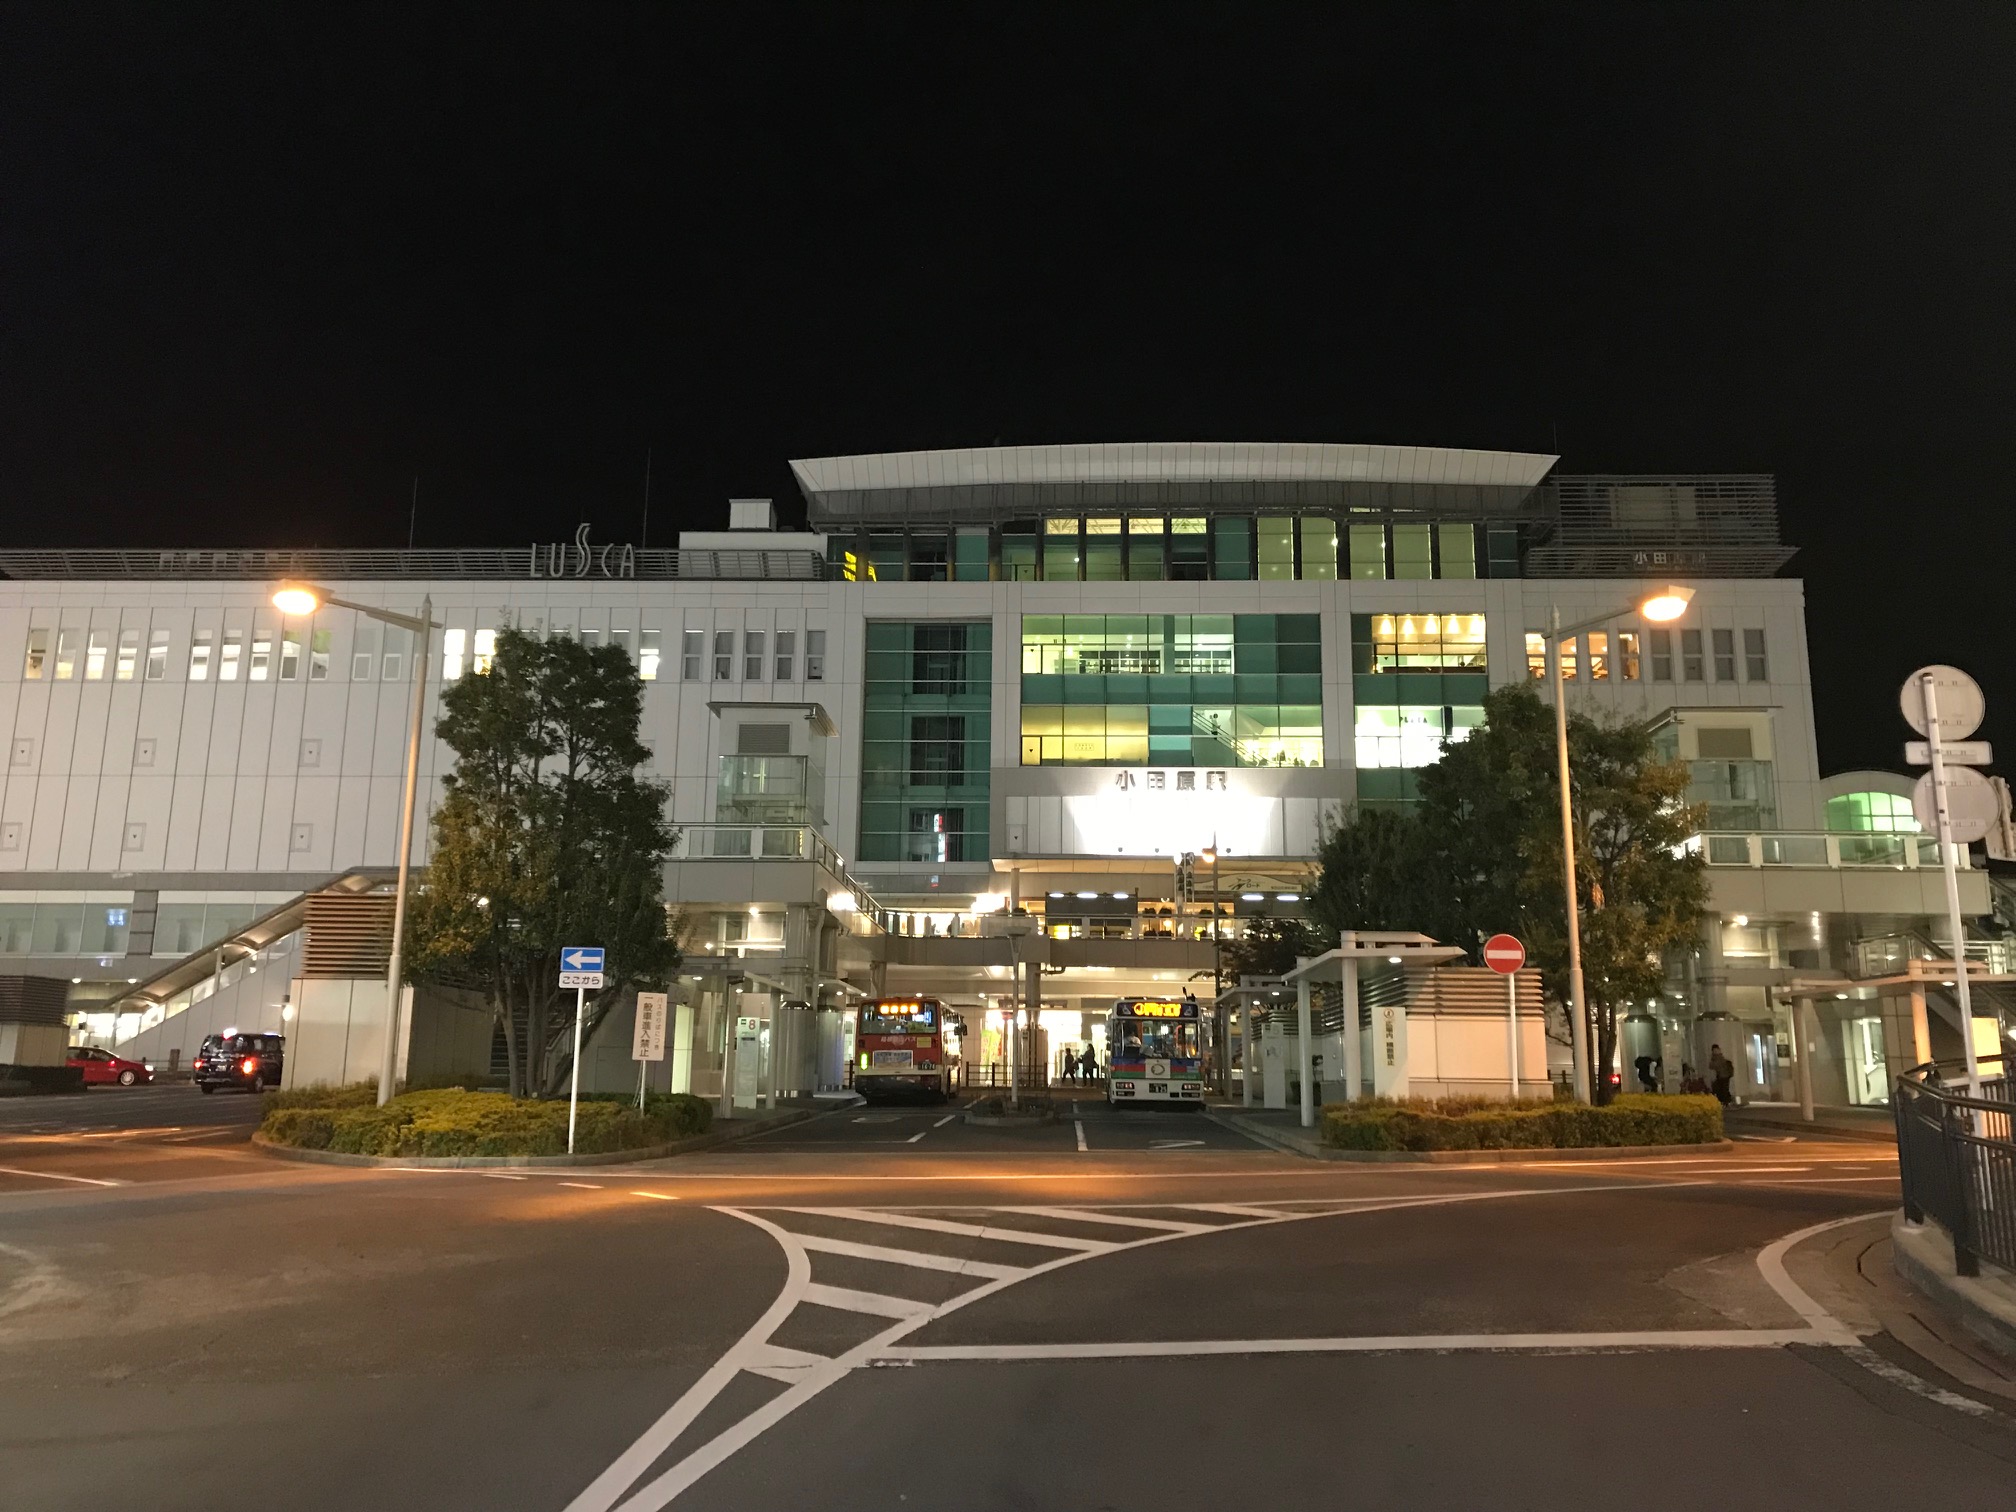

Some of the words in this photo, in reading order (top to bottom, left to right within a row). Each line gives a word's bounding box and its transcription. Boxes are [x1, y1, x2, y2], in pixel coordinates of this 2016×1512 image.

[530, 523, 635, 578] LUSCA
[562, 975, 600, 985] ここから
[639, 996, 654, 1058] 一般車進入禁止
[749, 1019, 756, 1030] 8
